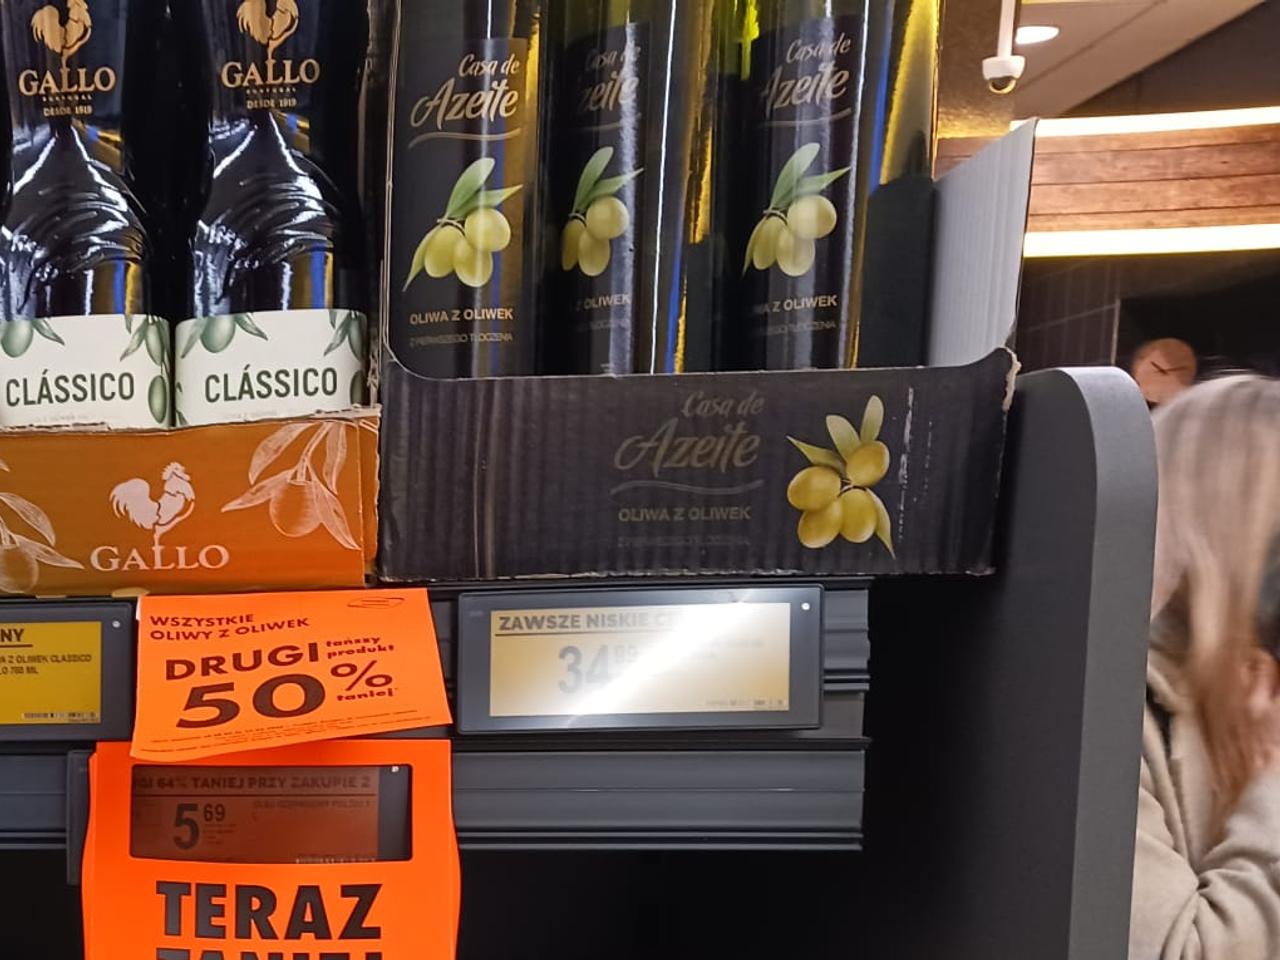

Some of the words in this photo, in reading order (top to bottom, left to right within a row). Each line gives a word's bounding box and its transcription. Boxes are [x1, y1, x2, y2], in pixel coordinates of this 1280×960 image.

[221, 59, 320, 88] GALLO
[458, 54, 497, 77] Casa
[500, 53, 520, 74] de
[19, 66, 116, 96] GALLO
[410, 78, 519, 130] Azeite
[409, 311, 449, 325] OLIWA
[451, 310, 460, 321] Z
[463, 308, 513, 321] OLIWEK
[783, 295, 838, 311] OLIWEK
[6, 369, 135, 406] CLÁSSICO
[205, 365, 337, 403] CLÁSSICO
[682, 391, 734, 418] Casa
[737, 390, 765, 417] de
[614, 417, 761, 477] Azeite
[618, 508, 670, 522] OLIWA
[673, 508, 685, 521] Z
[687, 506, 752, 521] OLIWEK
[90, 543, 230, 572] GALLO
[149, 613, 254, 627] WSZYSTKIE
[150, 630, 212, 641] OLIWY
[218, 629, 230, 639] Z
[235, 617, 310, 636] OLIWEK
[499, 614, 581, 631] ZAWSZE
[586, 612, 650, 629] NISKIE
[165, 642, 320, 681] DRUGI
[326, 644, 395, 660] produkt
[191, 776, 244, 790] TANIEJ
[248, 776, 286, 789] PRZY
[173, 802, 201, 850] 5
[203, 802, 226, 822] 69
[155, 880, 383, 940] TERAZ
